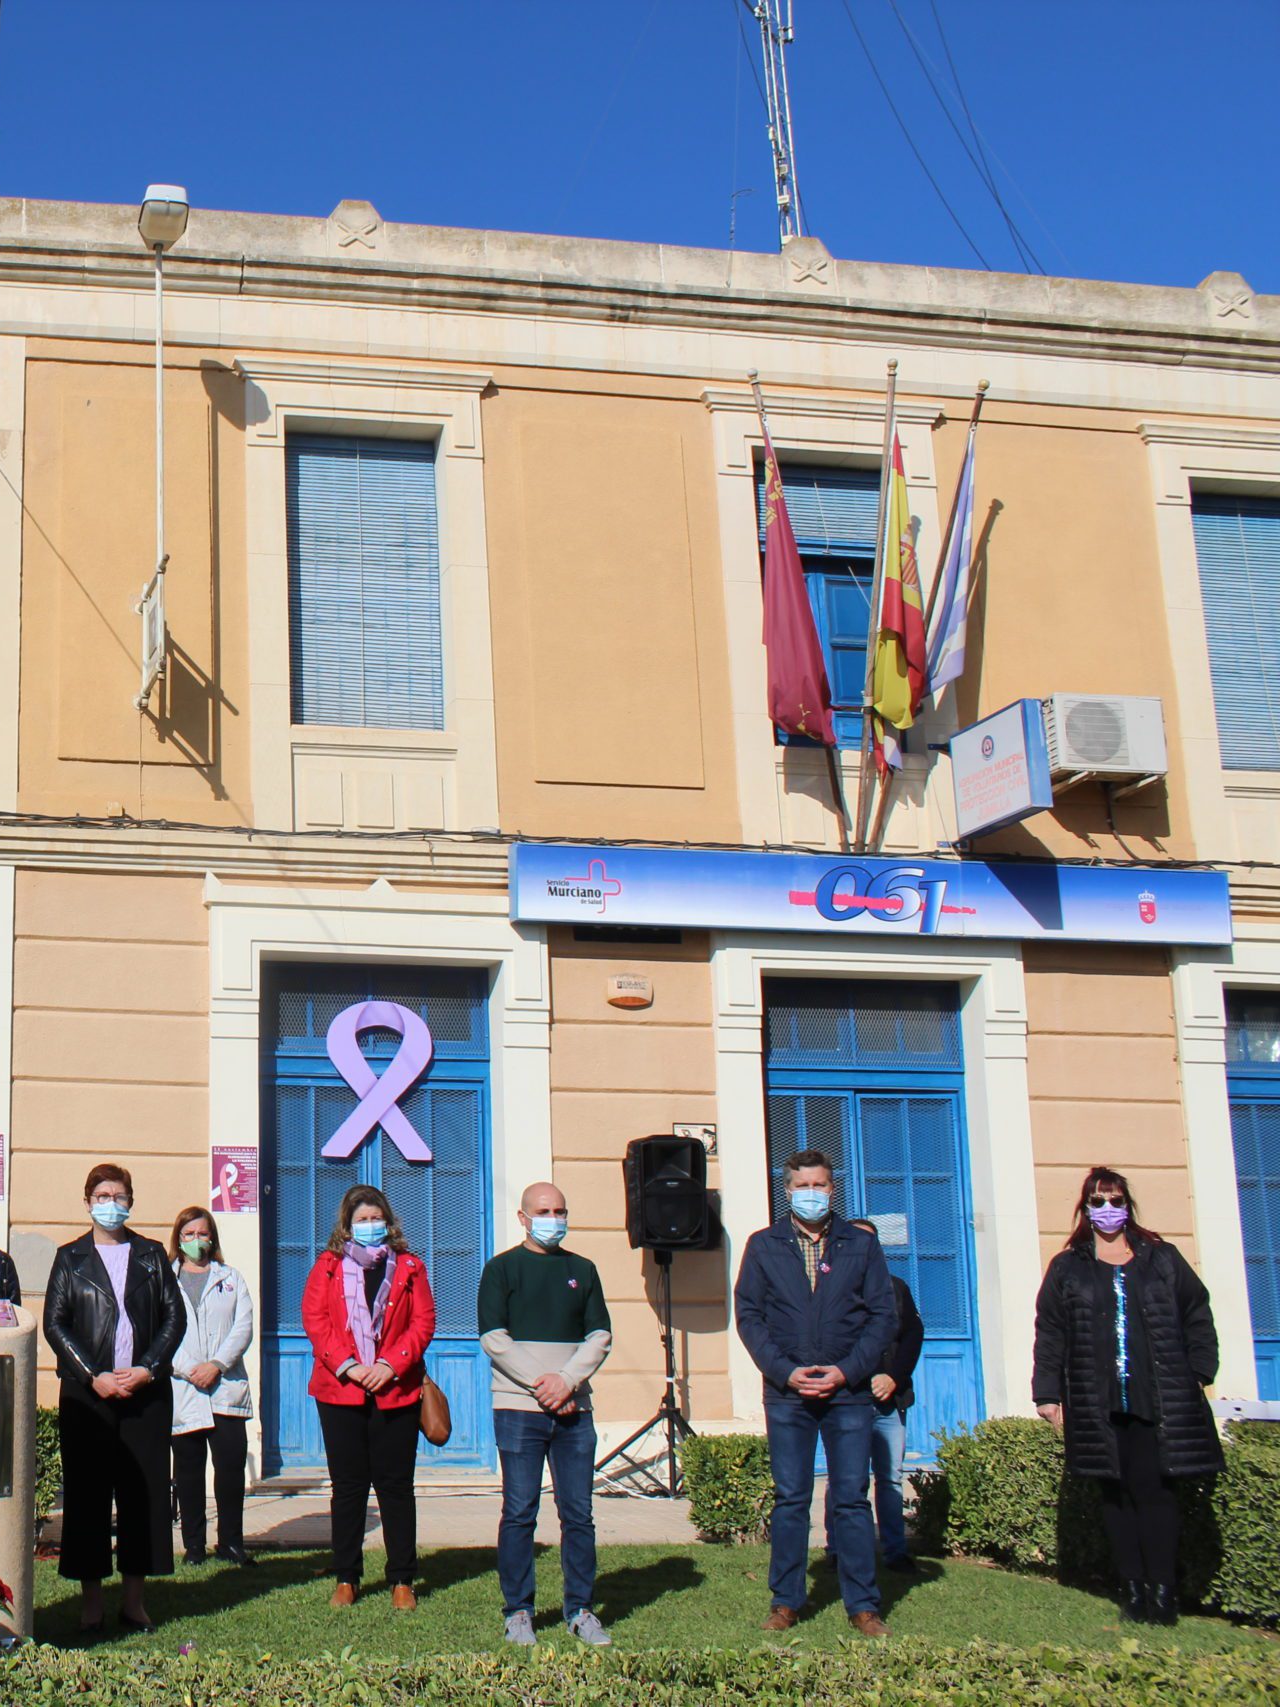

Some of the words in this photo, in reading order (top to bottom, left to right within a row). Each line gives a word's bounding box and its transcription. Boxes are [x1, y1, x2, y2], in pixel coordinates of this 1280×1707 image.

[546, 879, 570, 887] Servicio
[547, 886, 602, 898] Murciano
[815, 865, 948, 934] 061
